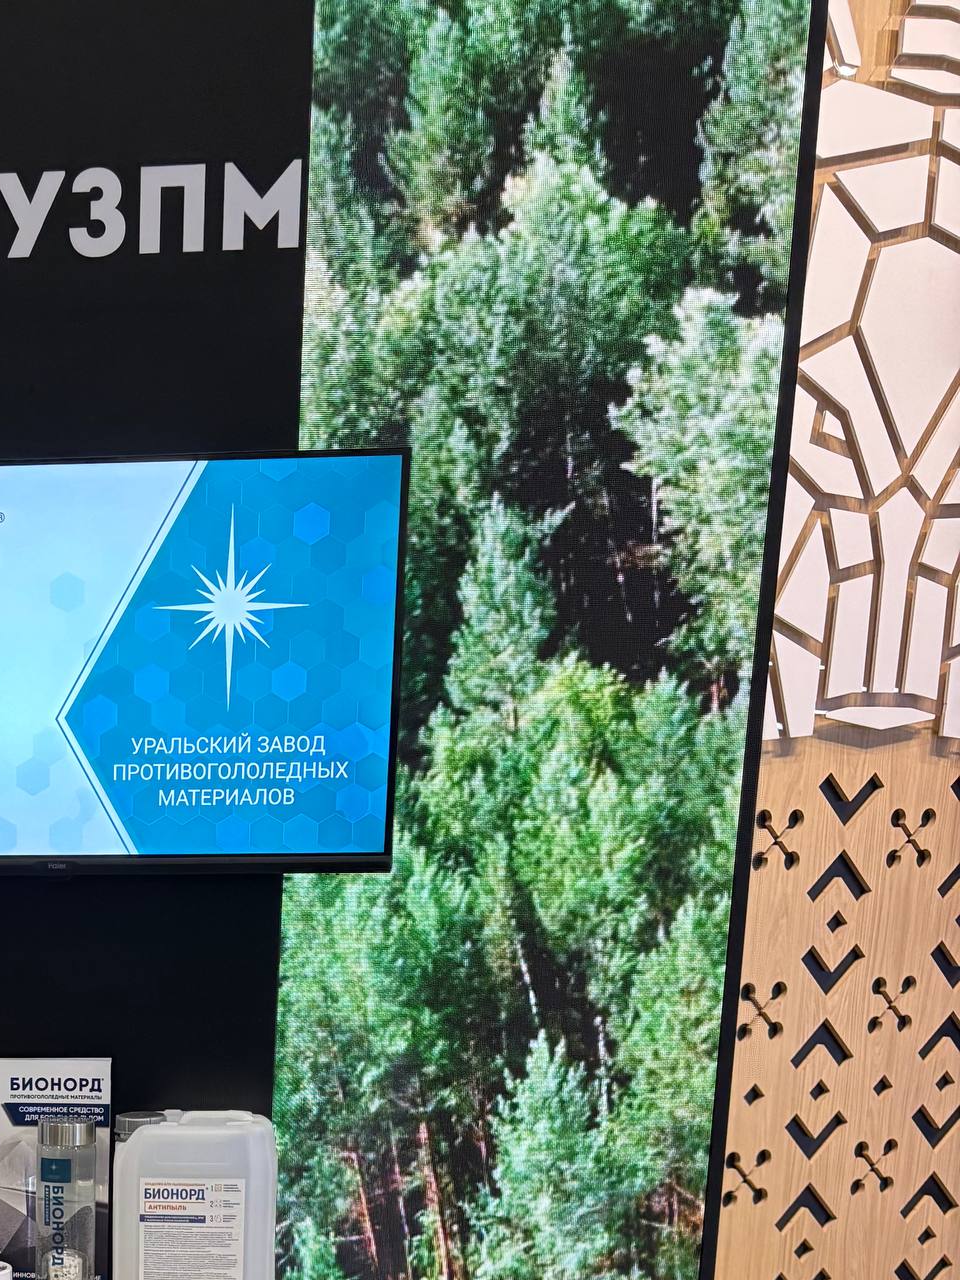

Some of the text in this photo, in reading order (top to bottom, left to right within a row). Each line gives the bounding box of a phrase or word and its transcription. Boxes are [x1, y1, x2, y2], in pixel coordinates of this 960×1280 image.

[131, 732, 326, 756] УРАЛЬСКИЙ ЗАВОД
[113, 760, 349, 782] ПРОТИВОГОЛОЛЕДНЫХ
[158, 788, 295, 807] МАТЕРИАЛОВ
[9, 1077, 103, 1093] БИОНОРД
[69, 1106, 104, 1114] СРЕДСТВО
[144, 1188, 205, 1200] БИОНОРД
[52, 1185, 64, 1266] БИОНОРД
